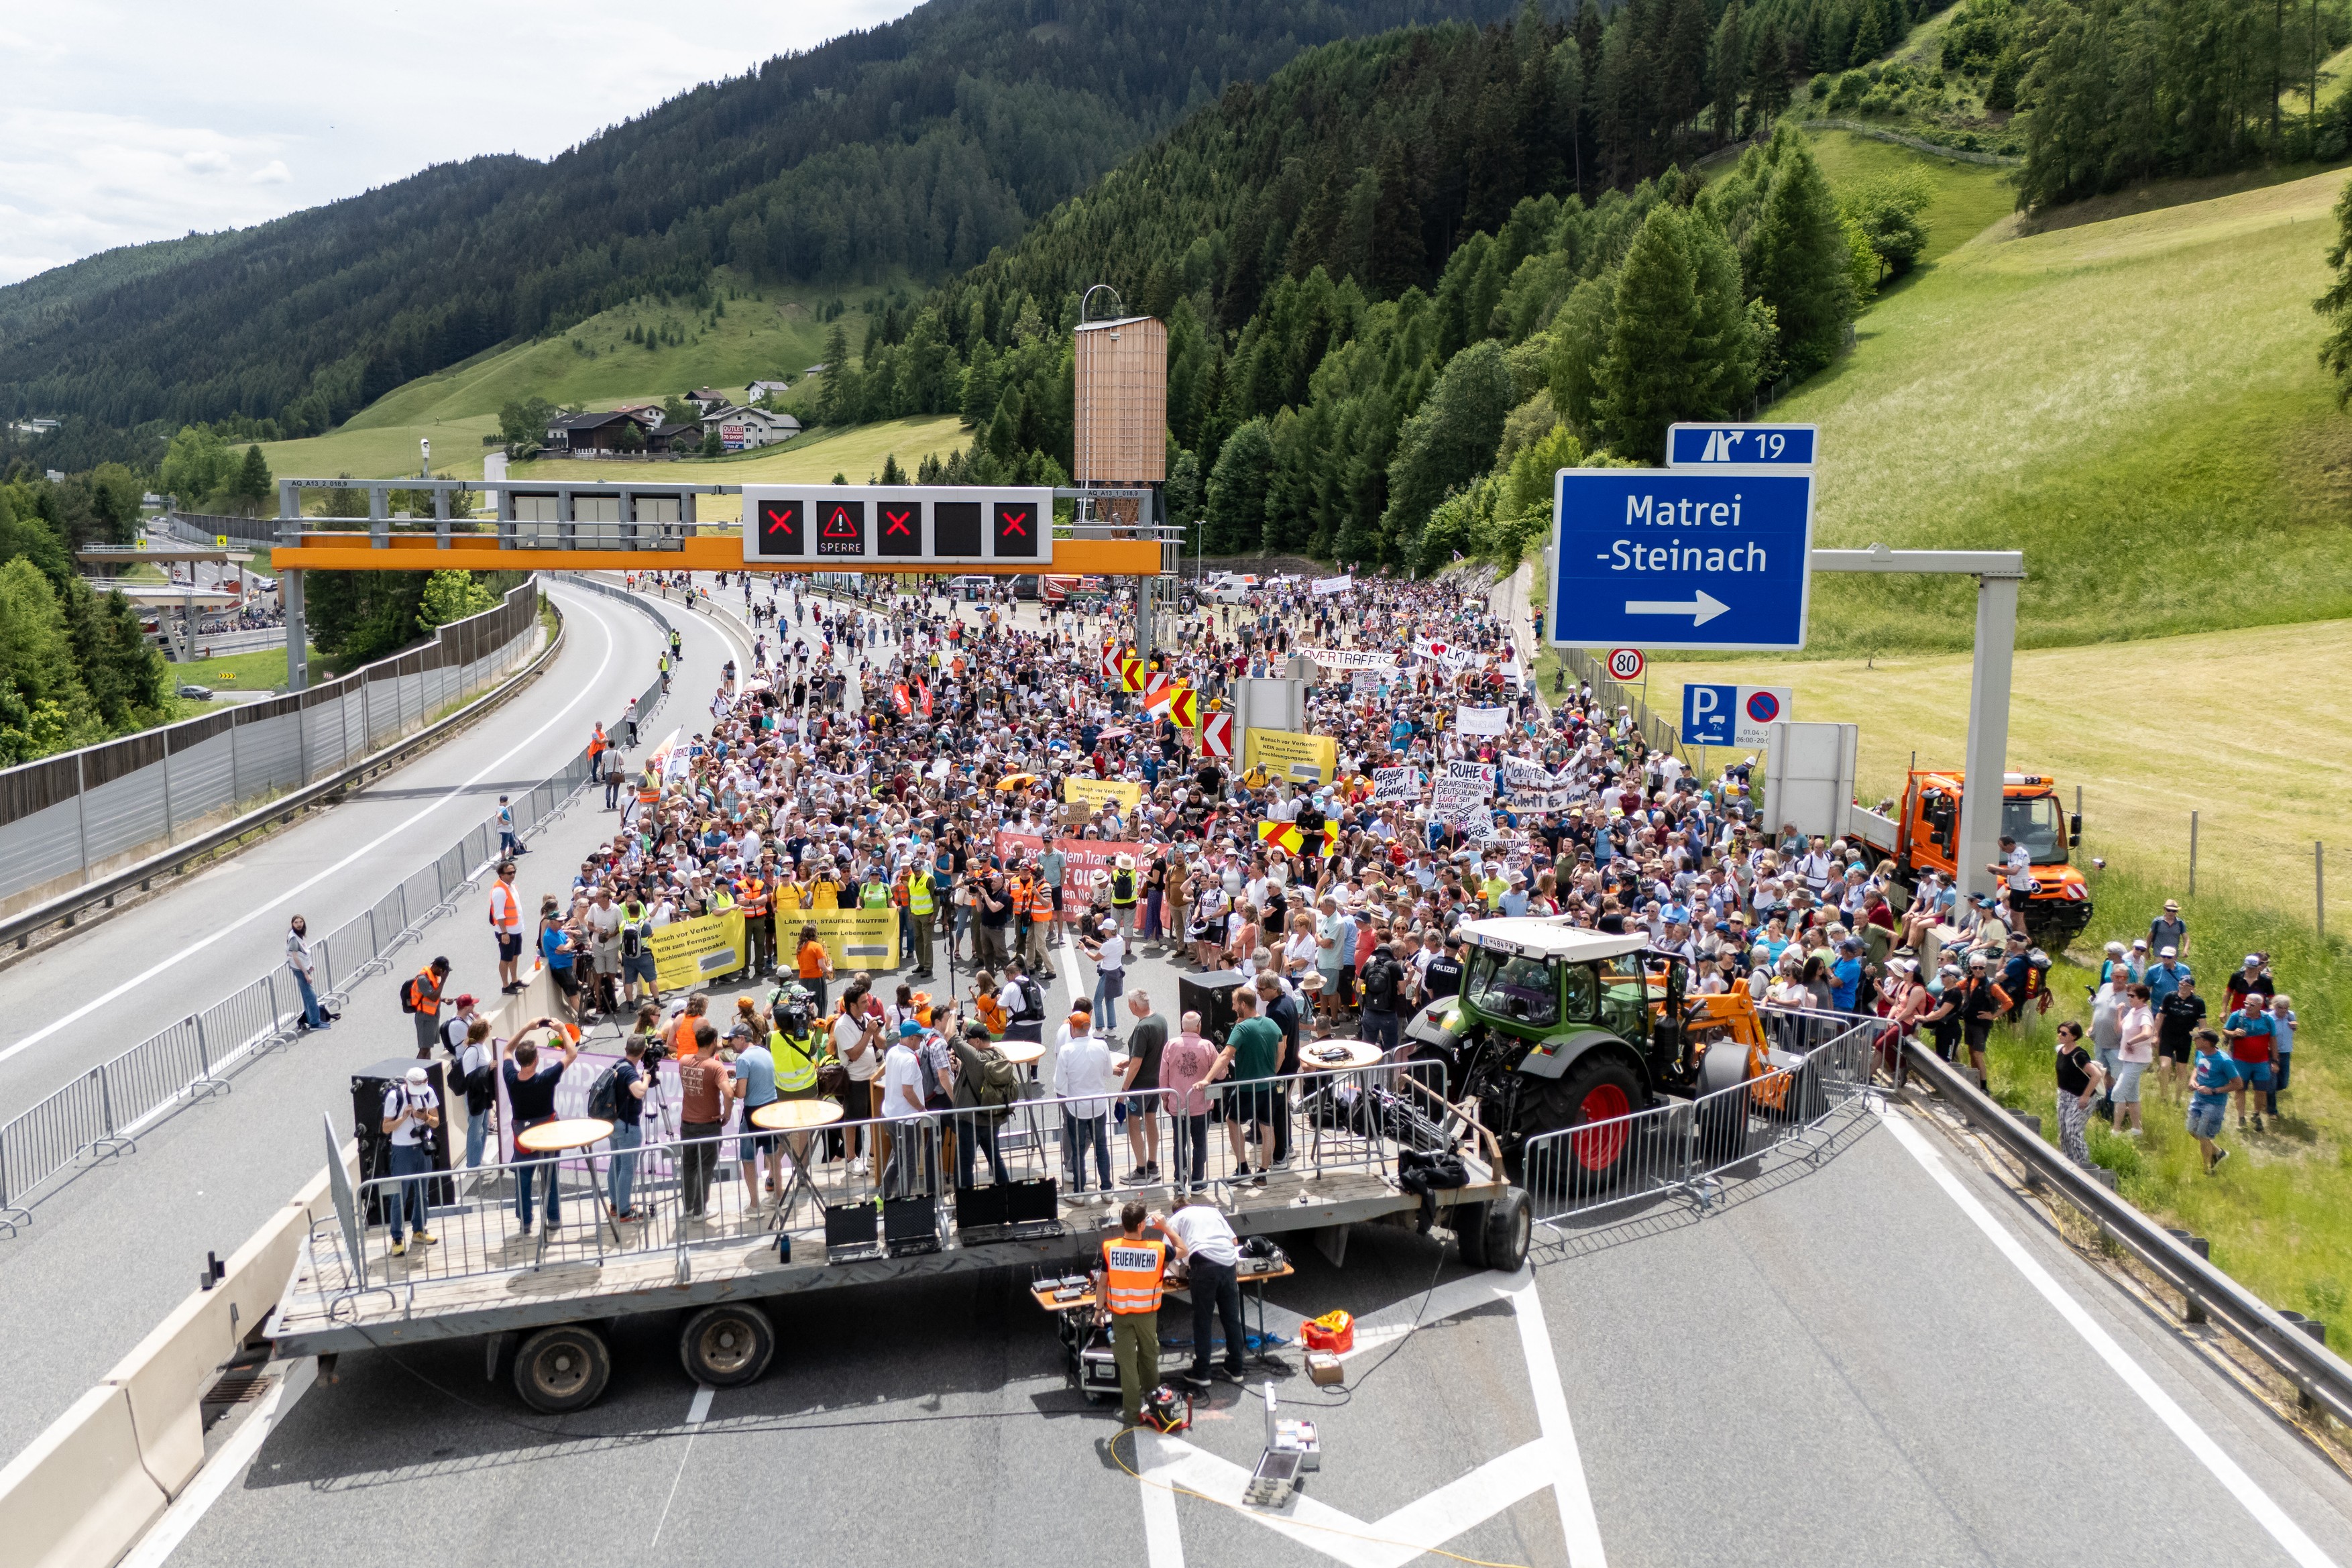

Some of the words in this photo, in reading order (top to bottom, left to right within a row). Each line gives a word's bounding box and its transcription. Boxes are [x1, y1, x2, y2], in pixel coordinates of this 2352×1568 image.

[1754, 434, 1785, 459] 19
[1626, 494, 1742, 526] Matrei
[820, 543, 861, 553] SPERRE
[1597, 539, 1766, 571] -Steinach
[1616, 655, 1636, 672] 80
[1692, 687, 1718, 726] P
[1258, 751, 1315, 762] Beschleunigungspaket
[1374, 769, 1404, 783] GENUG
[1385, 777, 1399, 787] IST
[1376, 783, 1406, 800] GENUG!
[1437, 779, 1485, 791] ZULAUFSTRECKEN?
[1437, 787, 1479, 797] DEUTSCHLAND
[1547, 795, 1562, 807] für
[1483, 840, 1529, 848] EINHALTUNG
[652, 934, 675, 944] Mensch
[690, 921, 724, 934] Verkehr!
[656, 940, 726, 964] Beschleunigungspaket
[658, 945, 671, 953] NEIN
[687, 934, 721, 946] Fernpass-
[1433, 963, 1457, 974] POLIZEI
[1111, 1251, 1156, 1268] FEUERWEHR
